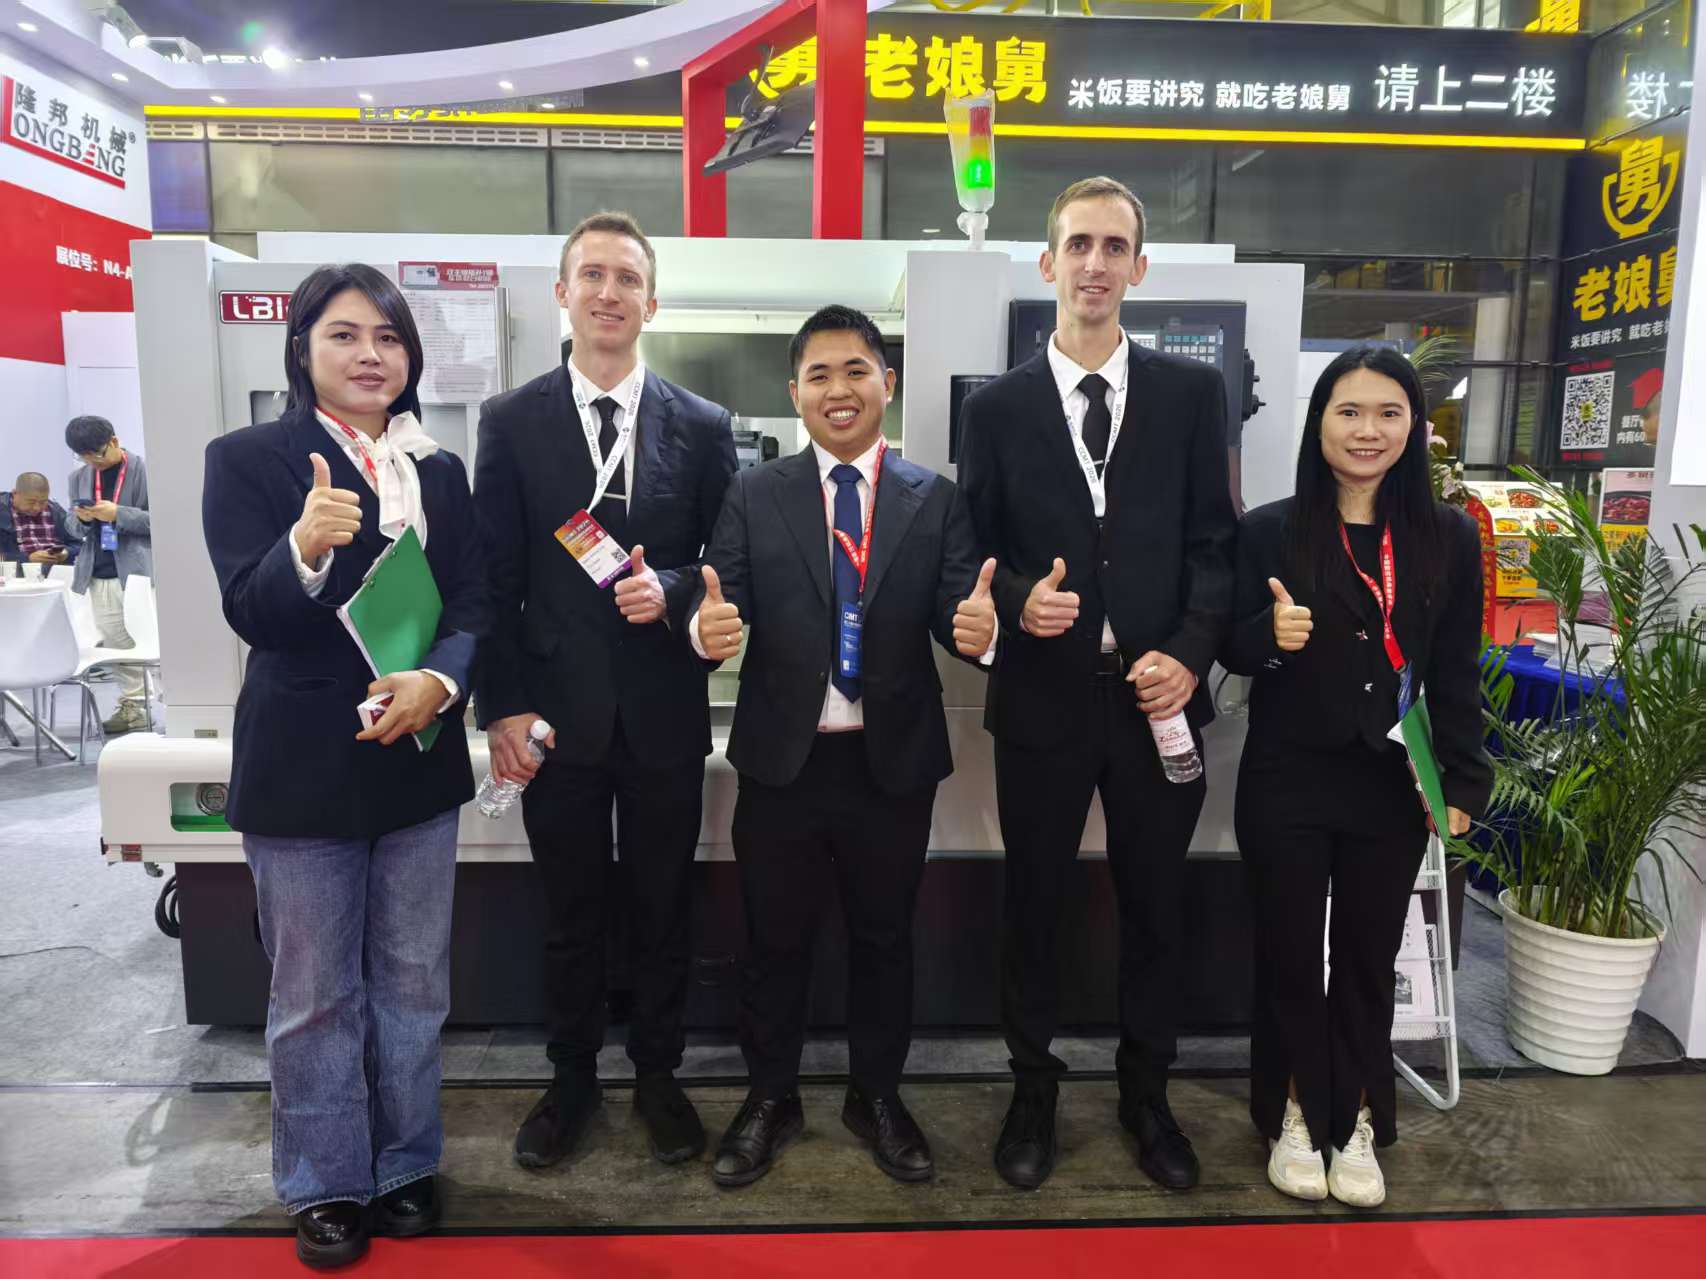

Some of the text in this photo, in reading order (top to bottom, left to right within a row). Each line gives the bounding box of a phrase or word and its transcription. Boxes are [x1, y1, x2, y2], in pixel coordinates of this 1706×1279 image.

[865, 33, 1047, 103] 老娘舅
[1375, 64, 1556, 117] 请上二楼
[1068, 78, 1350, 112] 米饭要讲究 就吃老娘舅
